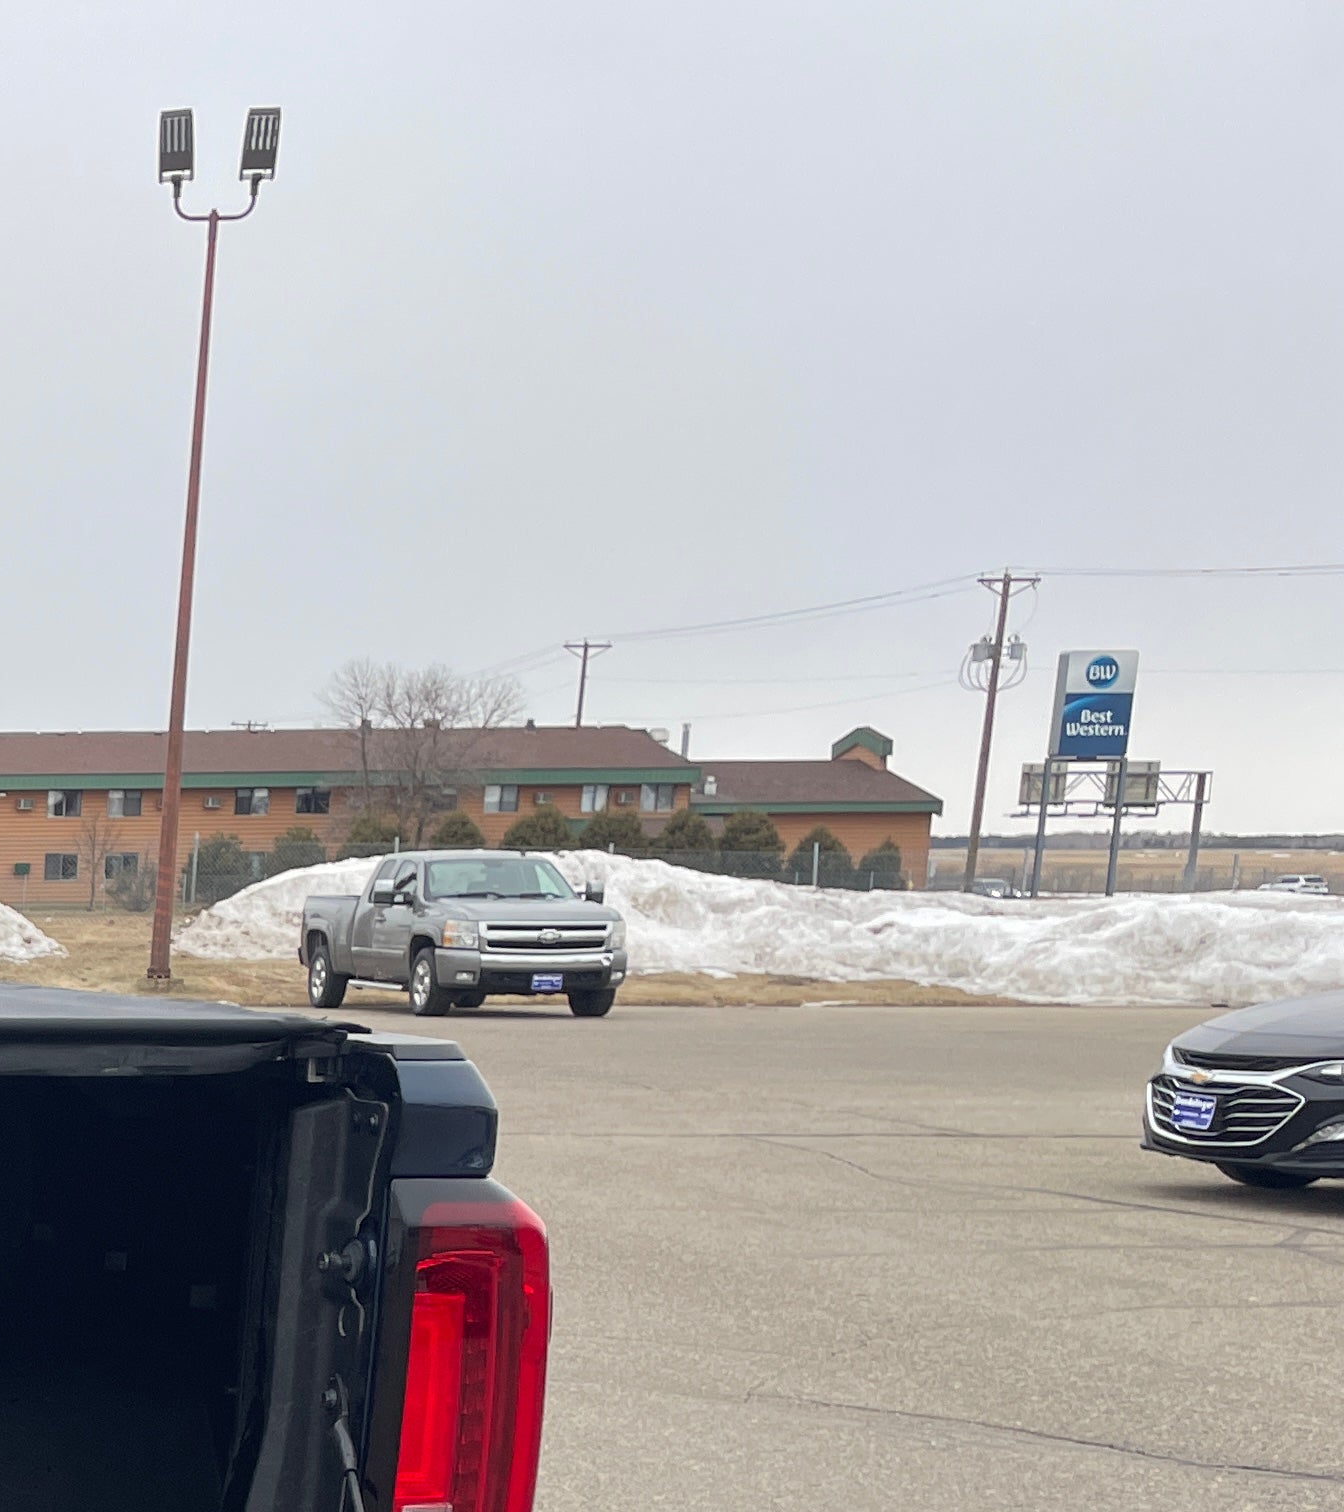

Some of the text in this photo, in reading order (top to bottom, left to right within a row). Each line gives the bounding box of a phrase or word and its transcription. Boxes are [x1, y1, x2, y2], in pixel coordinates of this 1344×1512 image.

[1089, 665, 1116, 680] BW
[1081, 709, 1113, 724] Best
[1066, 722, 1124, 737] Western
